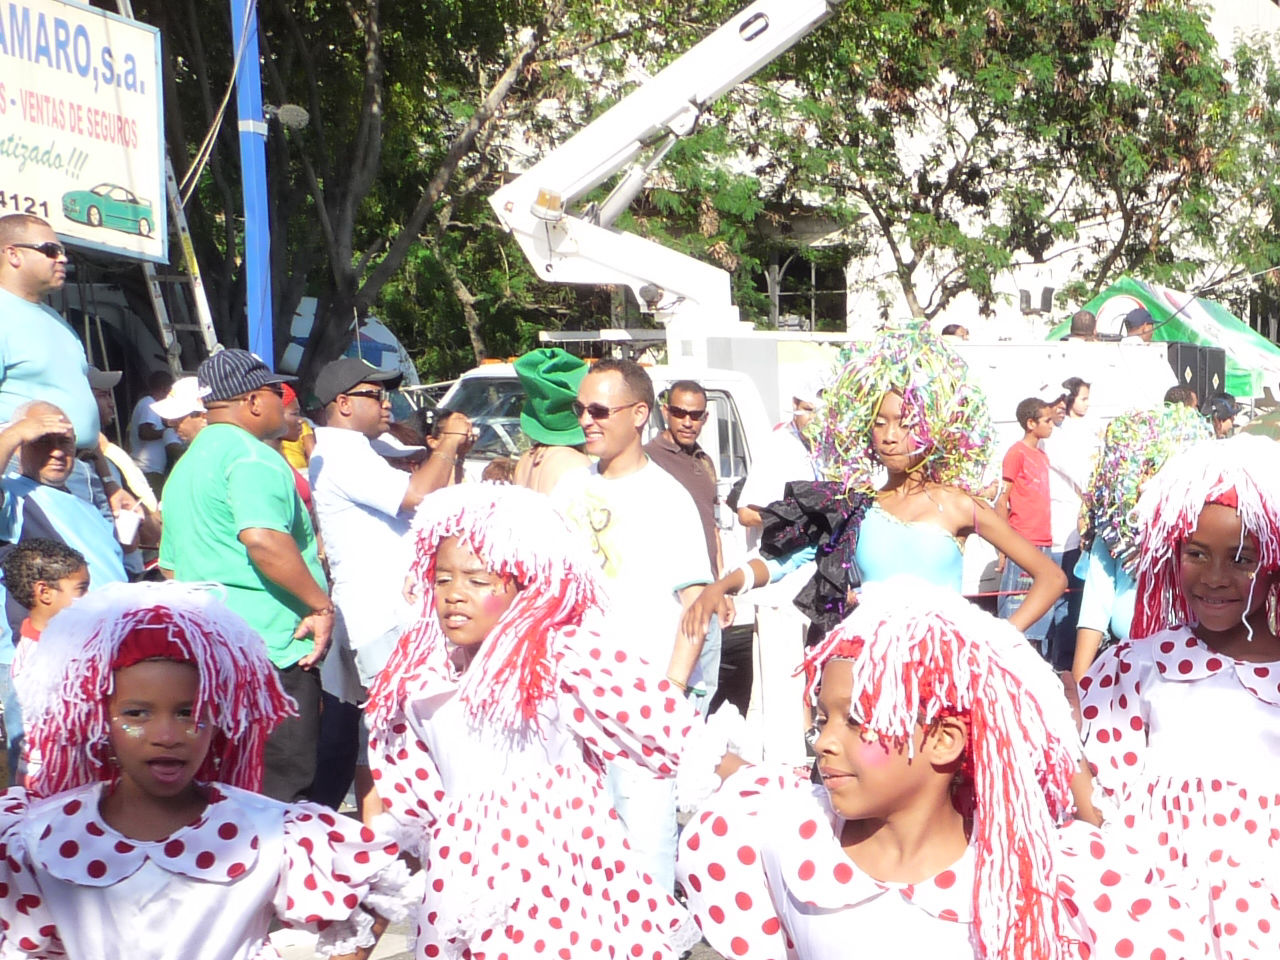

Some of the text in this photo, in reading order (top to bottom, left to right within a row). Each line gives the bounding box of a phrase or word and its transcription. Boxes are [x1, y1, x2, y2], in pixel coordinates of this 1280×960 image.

[20, 88, 66, 131] VENTAS
[69, 102, 84, 136] DE
[87, 107, 138, 150] SEGUROS
